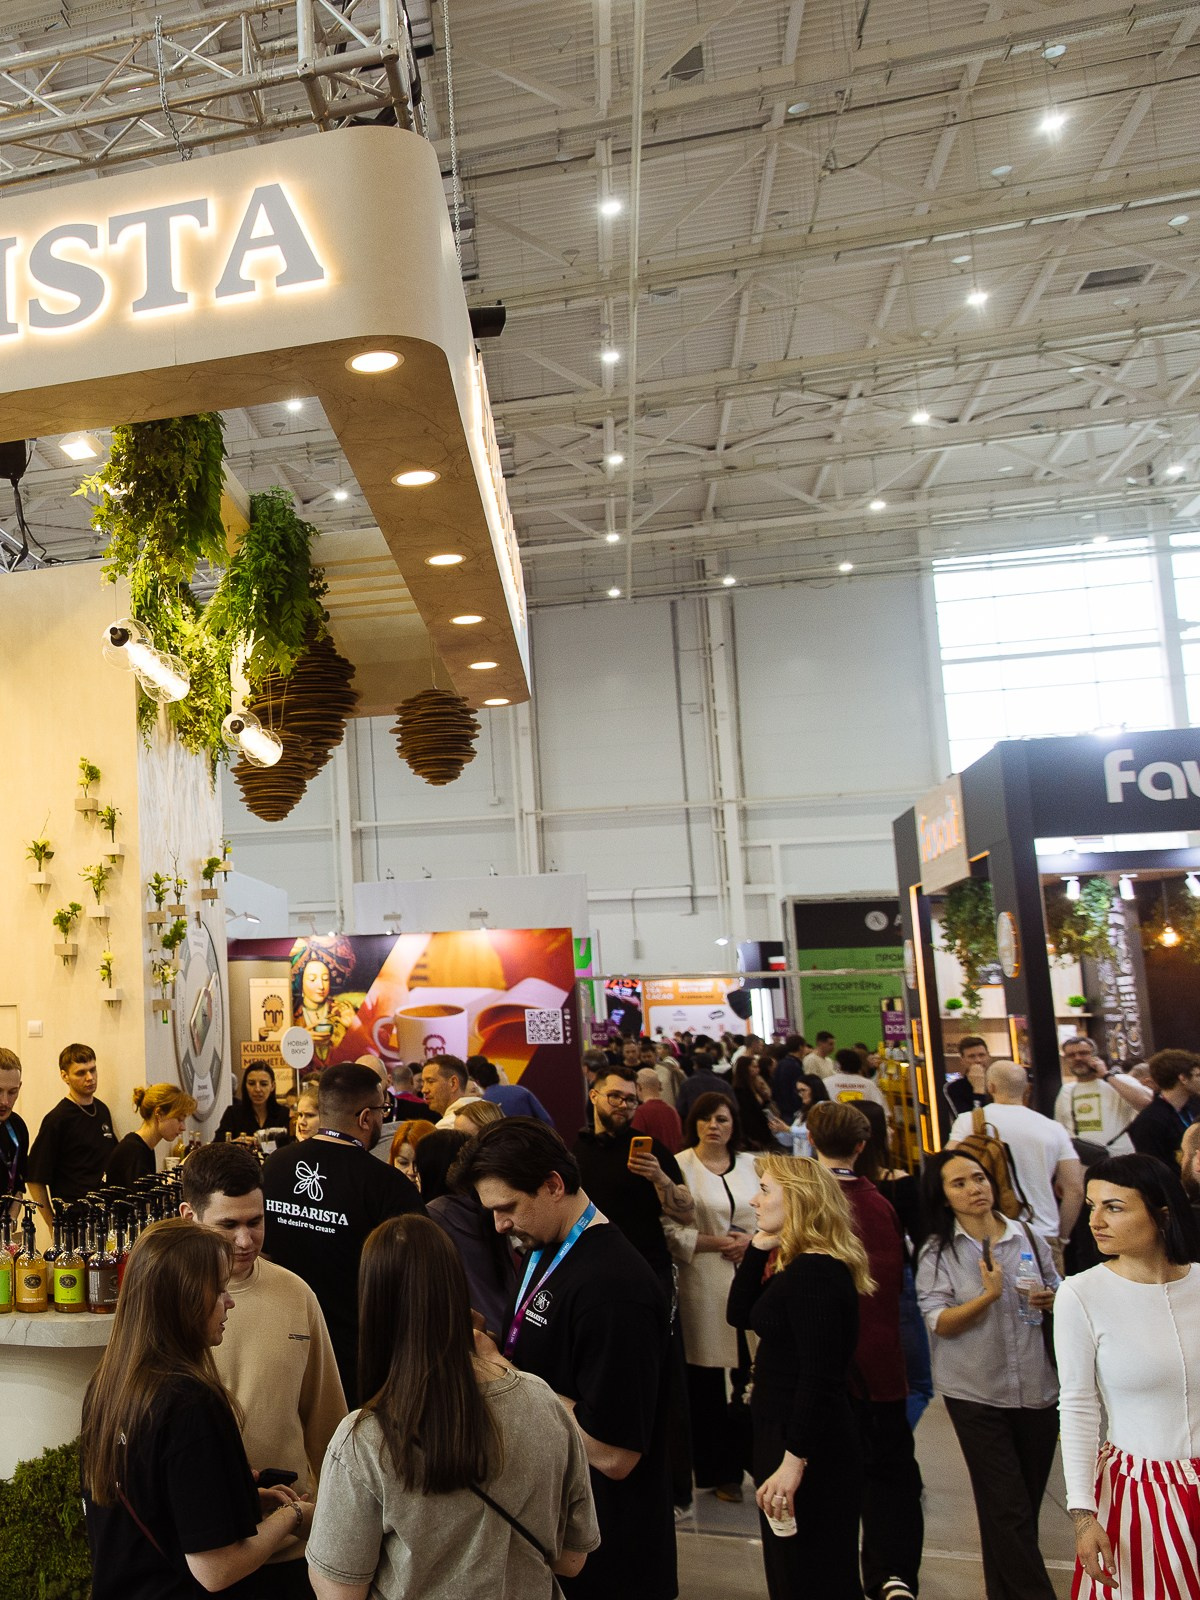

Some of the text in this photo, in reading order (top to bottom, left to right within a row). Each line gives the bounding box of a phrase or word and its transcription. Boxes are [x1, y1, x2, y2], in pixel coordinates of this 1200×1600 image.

[243, 1044, 281, 1054] KURUKA
[287, 1040, 309, 1048] НОВЫЙ
[265, 1199, 349, 1226] HERBARISTA
[277, 1216, 287, 1225] the
[287, 1219, 308, 1228] desire
[315, 1225, 336, 1234] create
